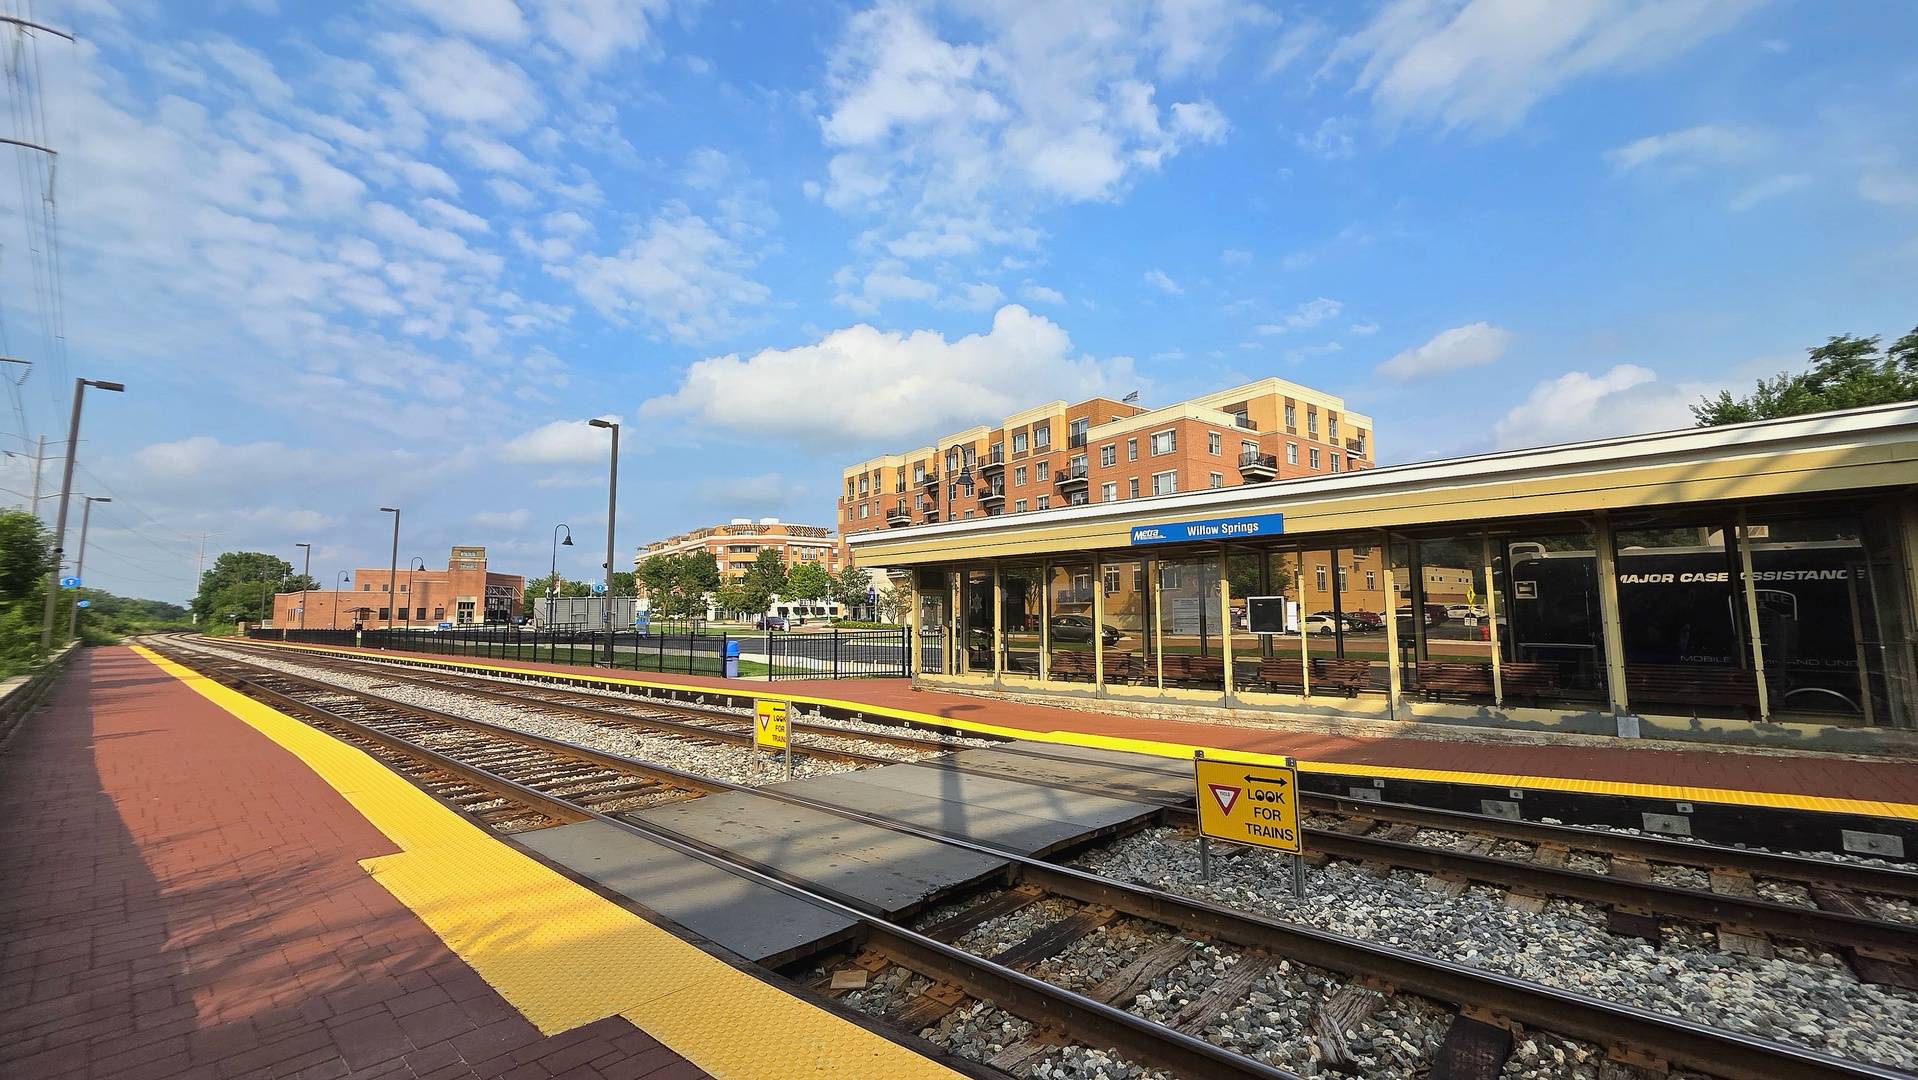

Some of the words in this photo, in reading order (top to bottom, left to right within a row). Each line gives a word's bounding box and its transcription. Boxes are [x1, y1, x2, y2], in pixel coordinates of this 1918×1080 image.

[1134, 529, 1159, 541] Metra
[1187, 525, 1219, 537] Willow
[1221, 522, 1259, 535] Springs
[1680, 572, 1729, 582] CASE
[1247, 788, 1285, 804] LOOK
[1254, 807, 1281, 821] FOR
[1245, 822, 1294, 841] TRAINS
